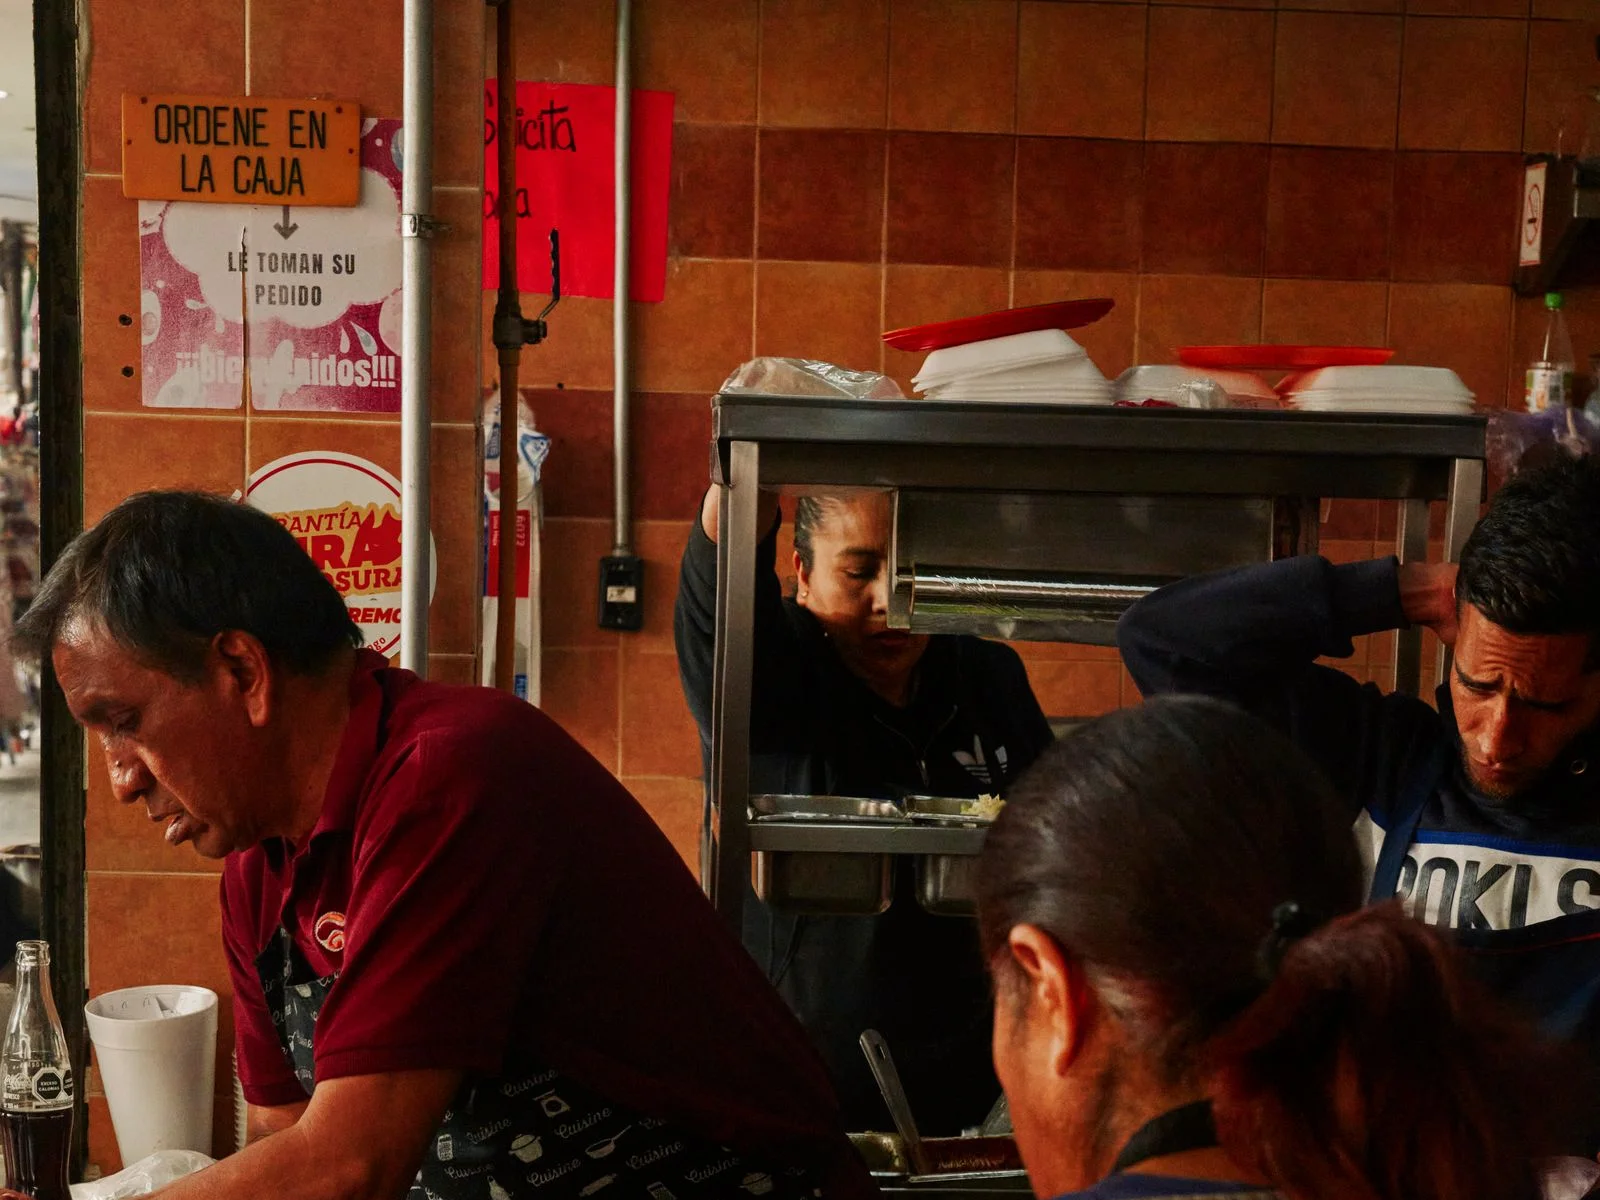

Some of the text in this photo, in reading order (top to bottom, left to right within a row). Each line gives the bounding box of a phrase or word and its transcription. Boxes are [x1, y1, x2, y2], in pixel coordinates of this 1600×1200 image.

[154, 104, 326, 149] ORDENE EN
[181, 154, 305, 196] LA CAJA
[227, 251, 355, 274] LE TOMAN SU
[255, 284, 322, 306] PEDIDO
[501, 1068, 560, 1098] Cuisine
[555, 1107, 612, 1138] Cuisine
[625, 1140, 685, 1171] Cuisine
[684, 1156, 741, 1184] Cuisine
[527, 1158, 582, 1188] Cuisine
